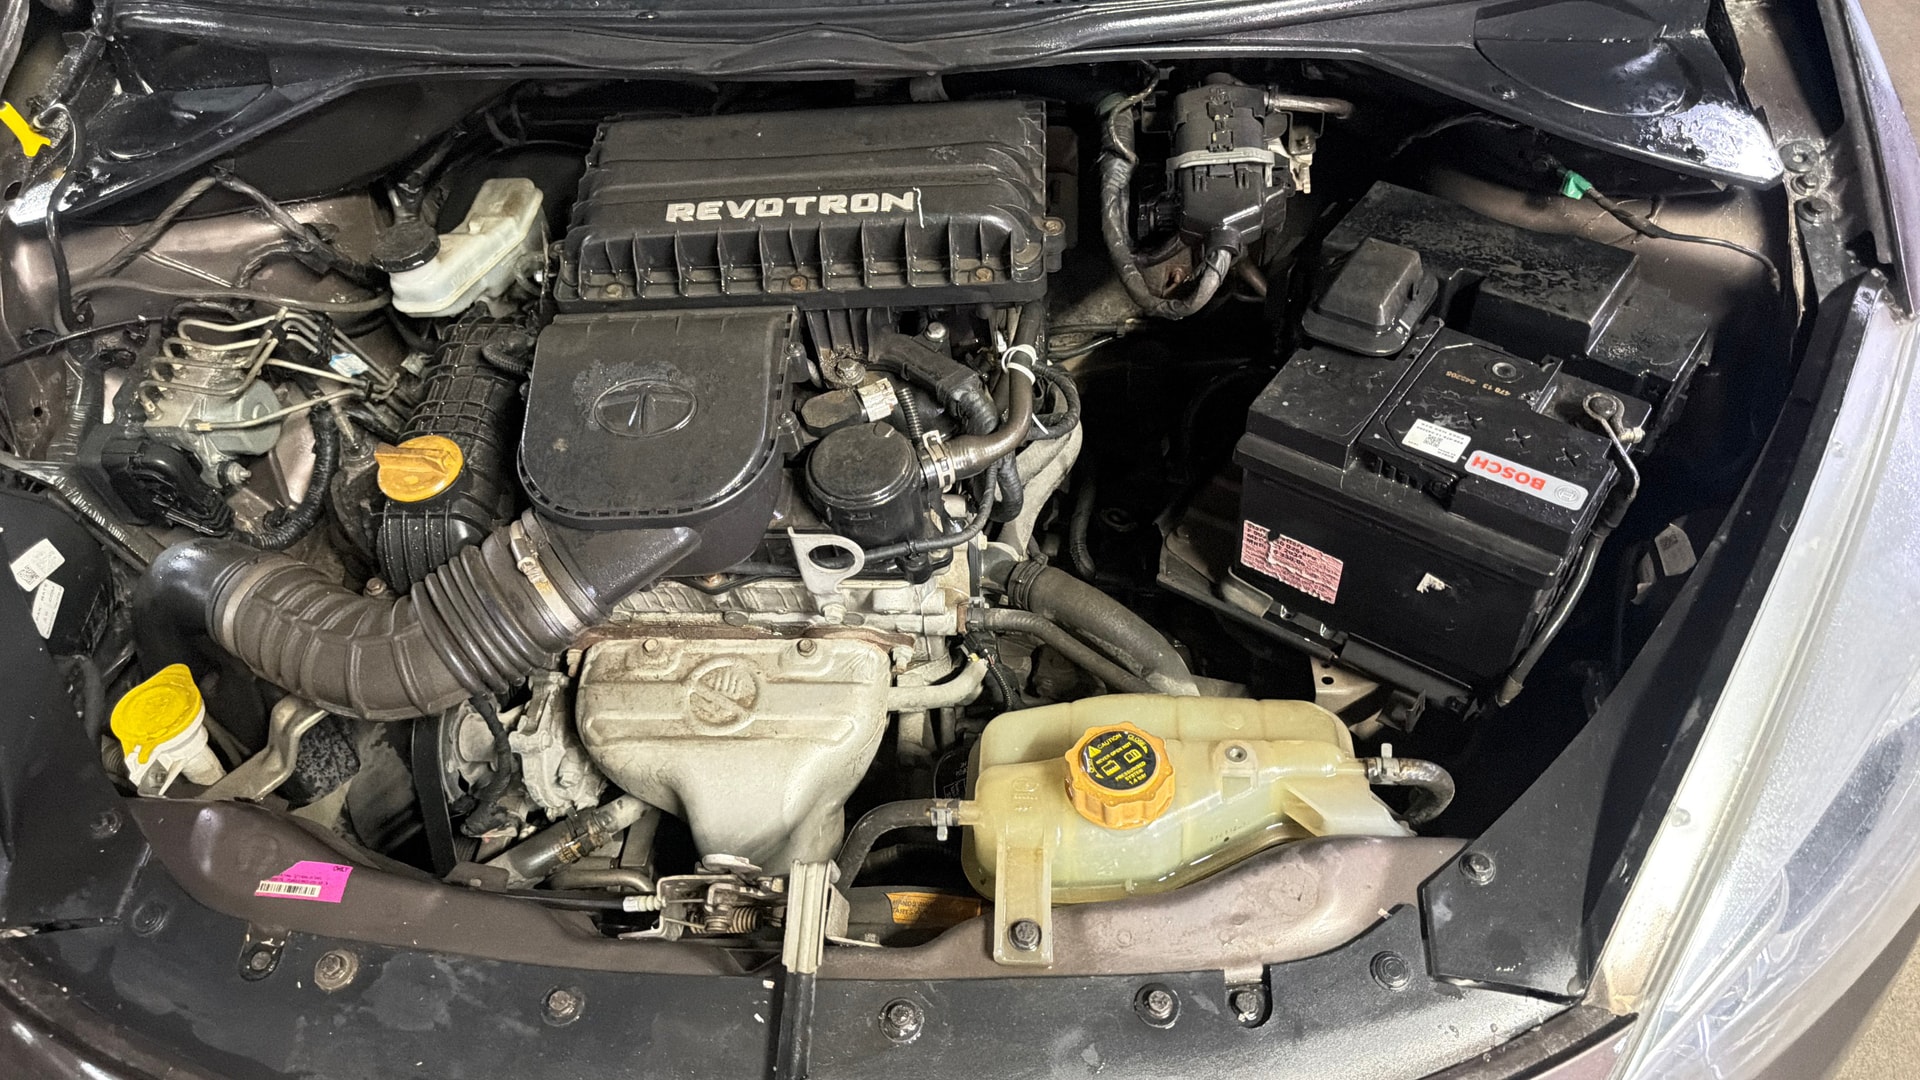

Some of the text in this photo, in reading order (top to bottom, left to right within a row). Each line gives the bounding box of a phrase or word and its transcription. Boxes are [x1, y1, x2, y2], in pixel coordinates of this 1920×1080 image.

[665, 191, 915, 223] REVOTRON
[1471, 456, 1547, 491] BOSCH
[1097, 733, 1122, 749] CAUTION
[1110, 747, 1123, 757] OPEN
